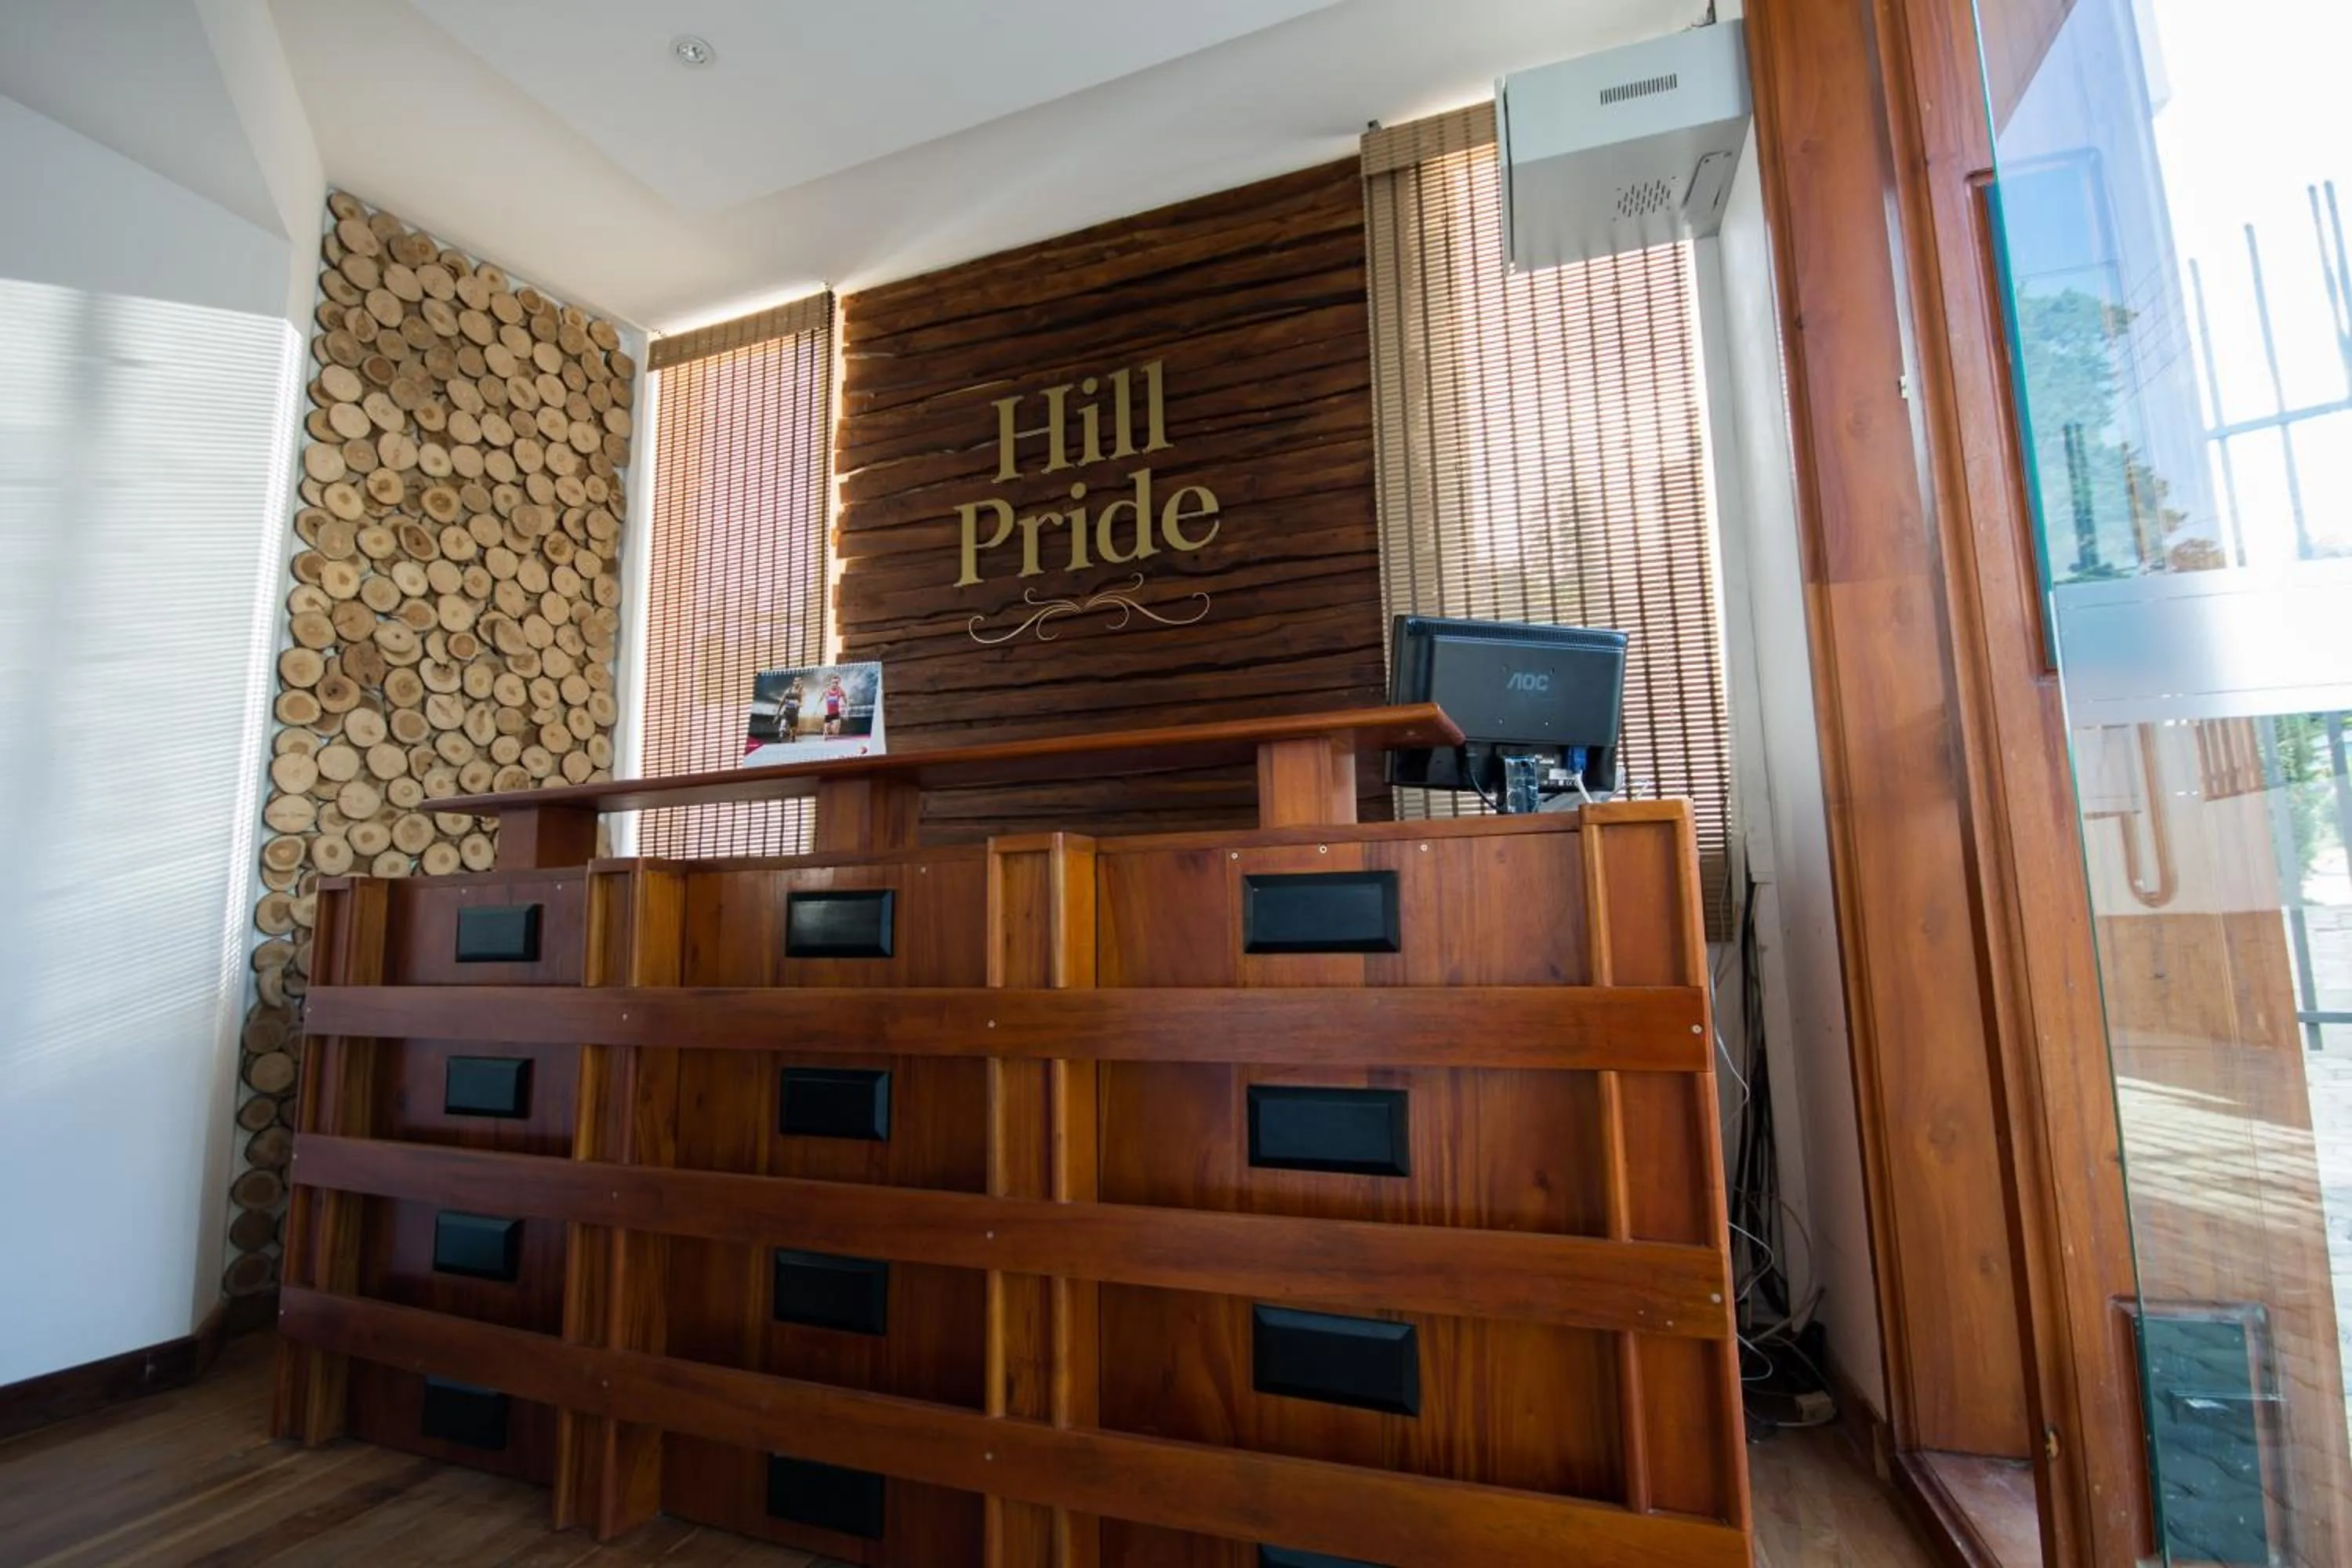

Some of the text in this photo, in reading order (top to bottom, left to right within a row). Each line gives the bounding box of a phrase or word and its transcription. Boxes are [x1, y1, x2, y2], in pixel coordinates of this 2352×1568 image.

[991, 359, 1174, 483] Hill
[953, 468, 1220, 587] Pride
[1506, 672, 1549, 691] AOC
